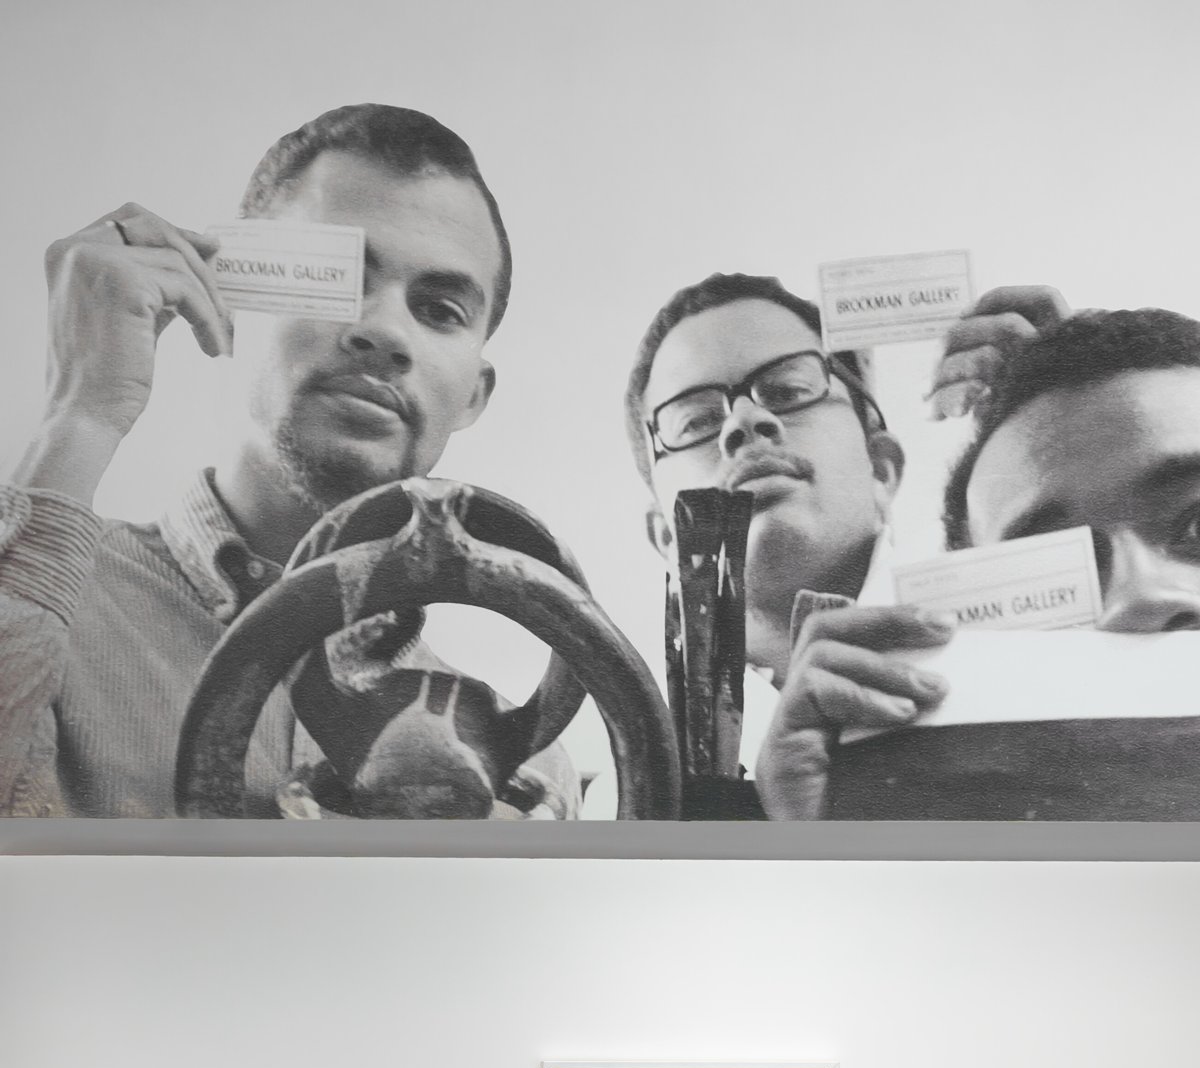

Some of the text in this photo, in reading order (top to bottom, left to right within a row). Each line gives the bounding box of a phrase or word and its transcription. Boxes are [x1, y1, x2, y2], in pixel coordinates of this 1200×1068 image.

[216, 257, 347, 283] BROCKMAN GALLERY
[836, 287, 960, 315] BROCKMAN GALLERY
[1012, 587, 1077, 615] GALLERY
